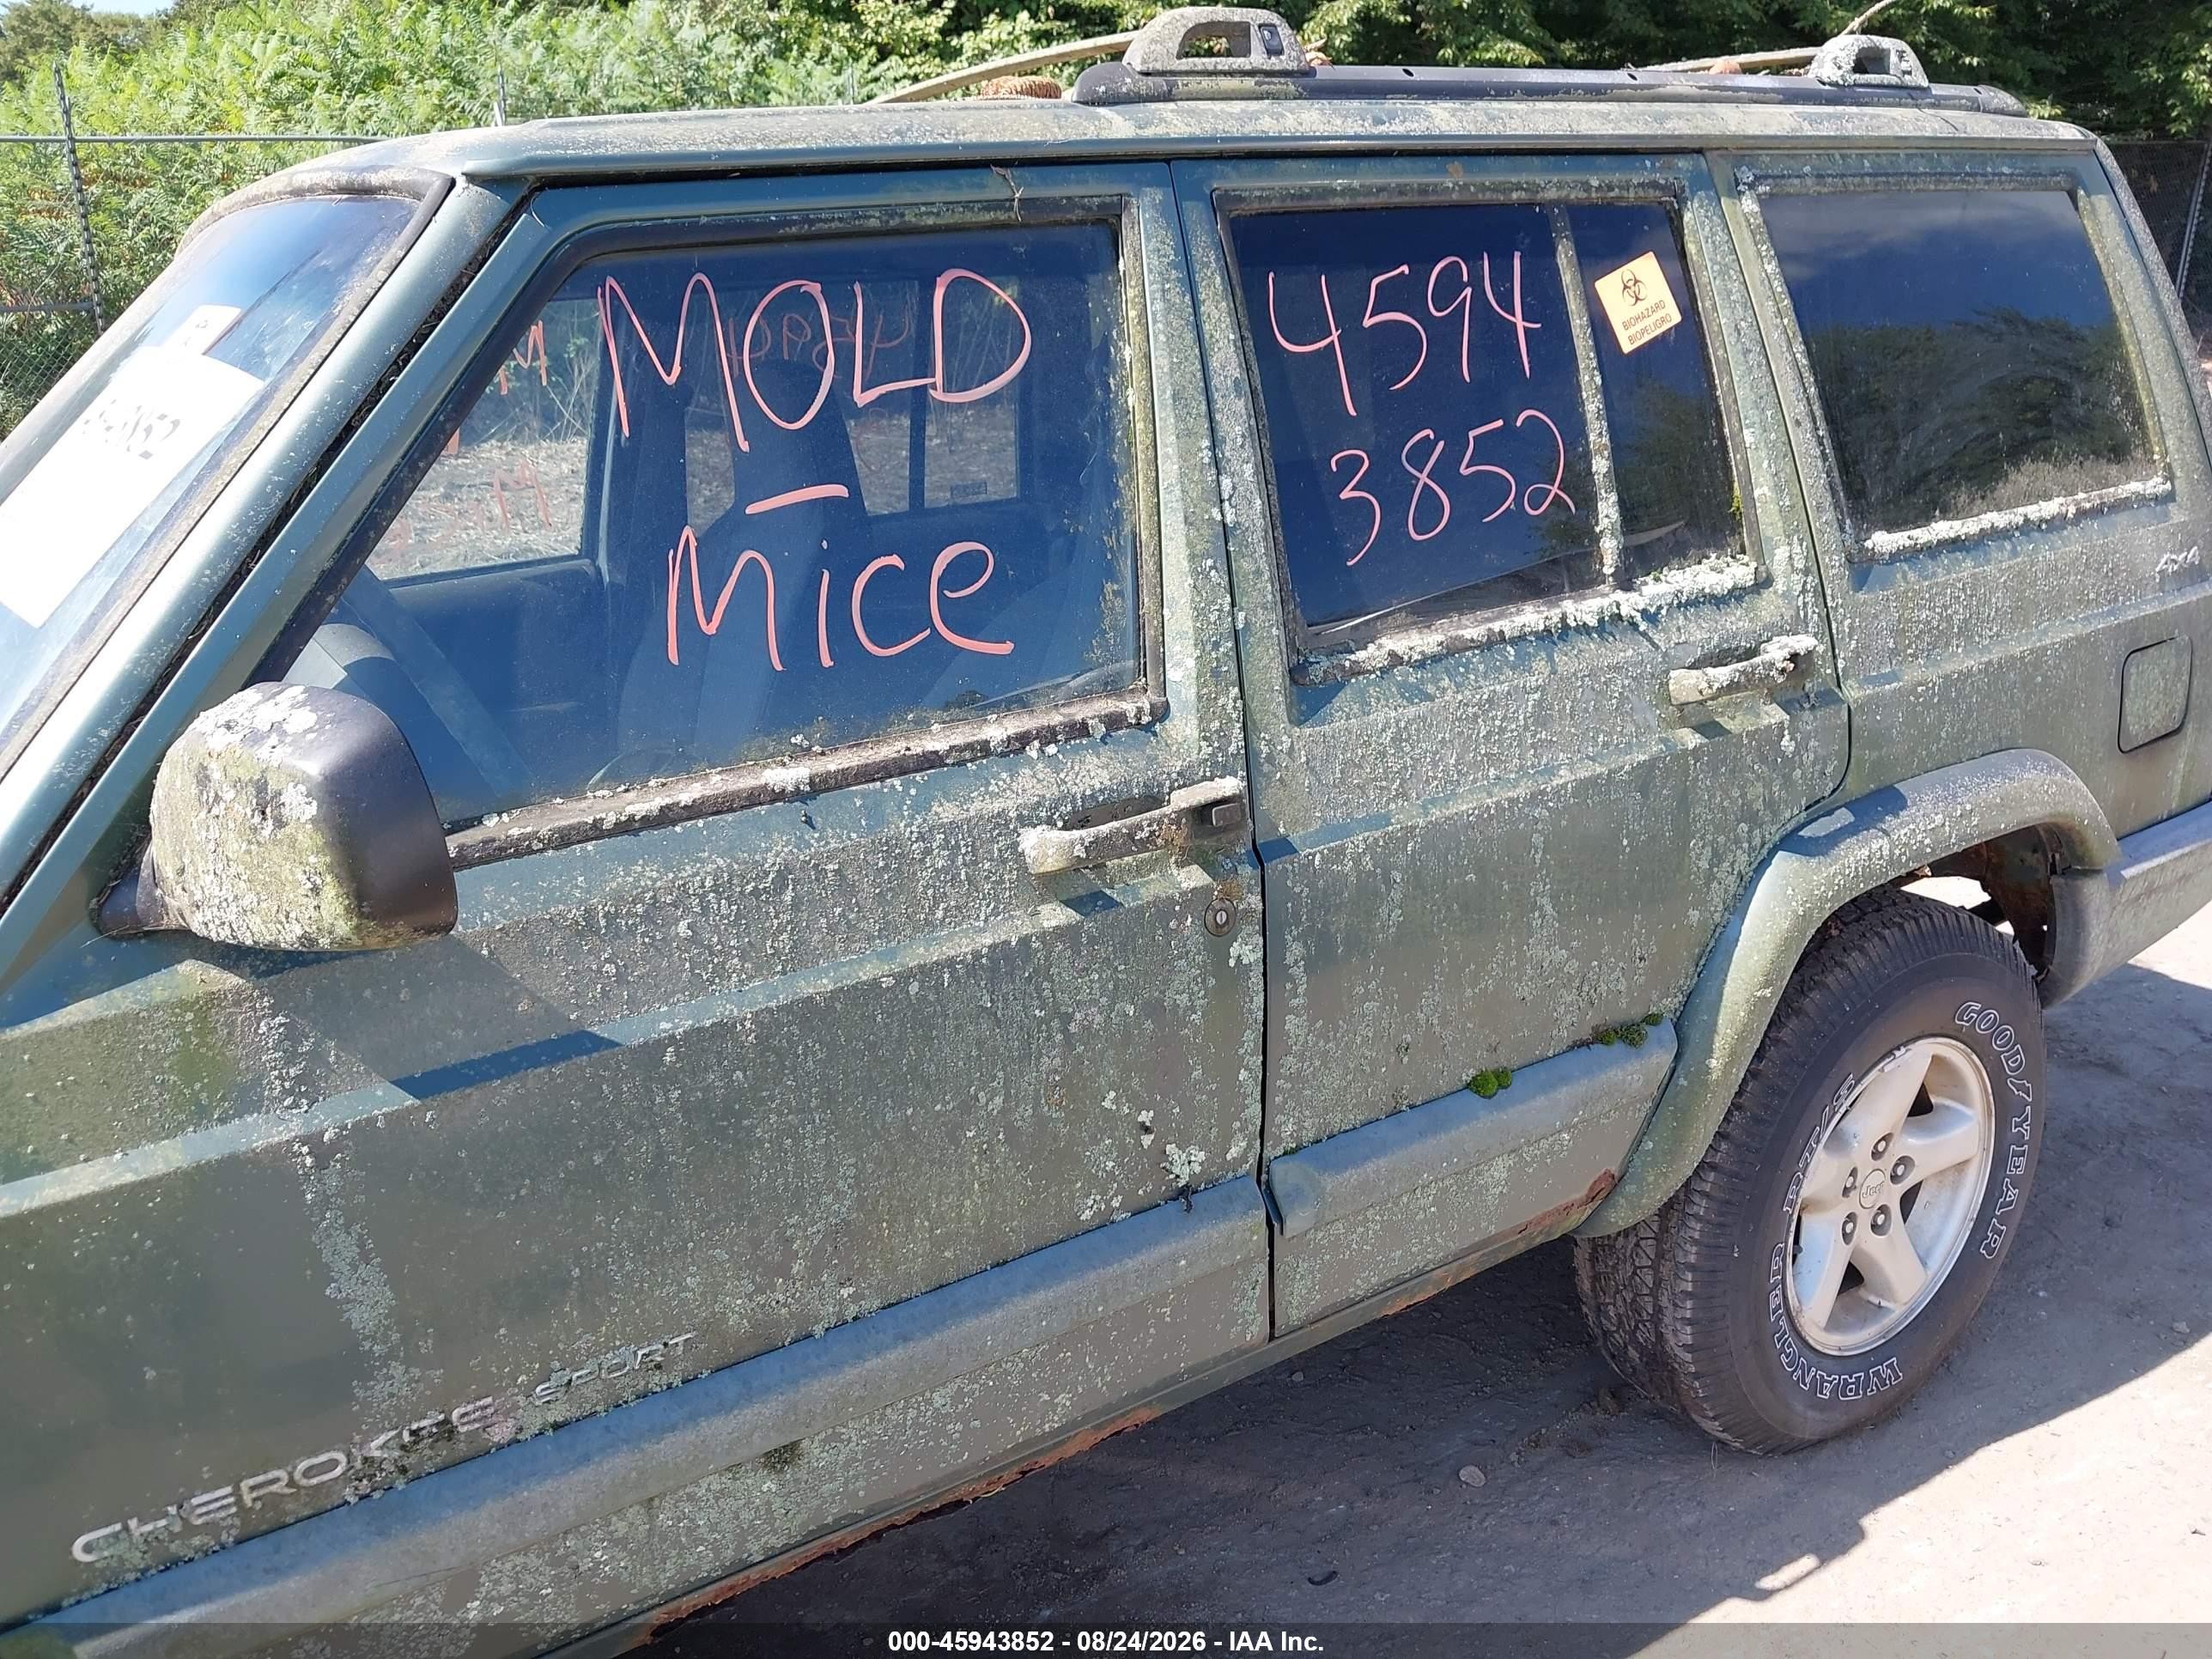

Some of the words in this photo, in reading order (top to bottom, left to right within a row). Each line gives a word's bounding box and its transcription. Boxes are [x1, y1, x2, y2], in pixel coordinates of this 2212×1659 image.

[597, 267, 1031, 453] MOLD
[1267, 251, 1542, 417] 4594
[1621, 300, 1666, 331] BIOHAZARD
[1627, 313, 1673, 345] BIOPELIGRO
[1330, 408, 1577, 567] 3852
[1954, 1000, 2033, 1261] GOODYEAR
[1769, 1243, 1904, 1401] WRANGLER
